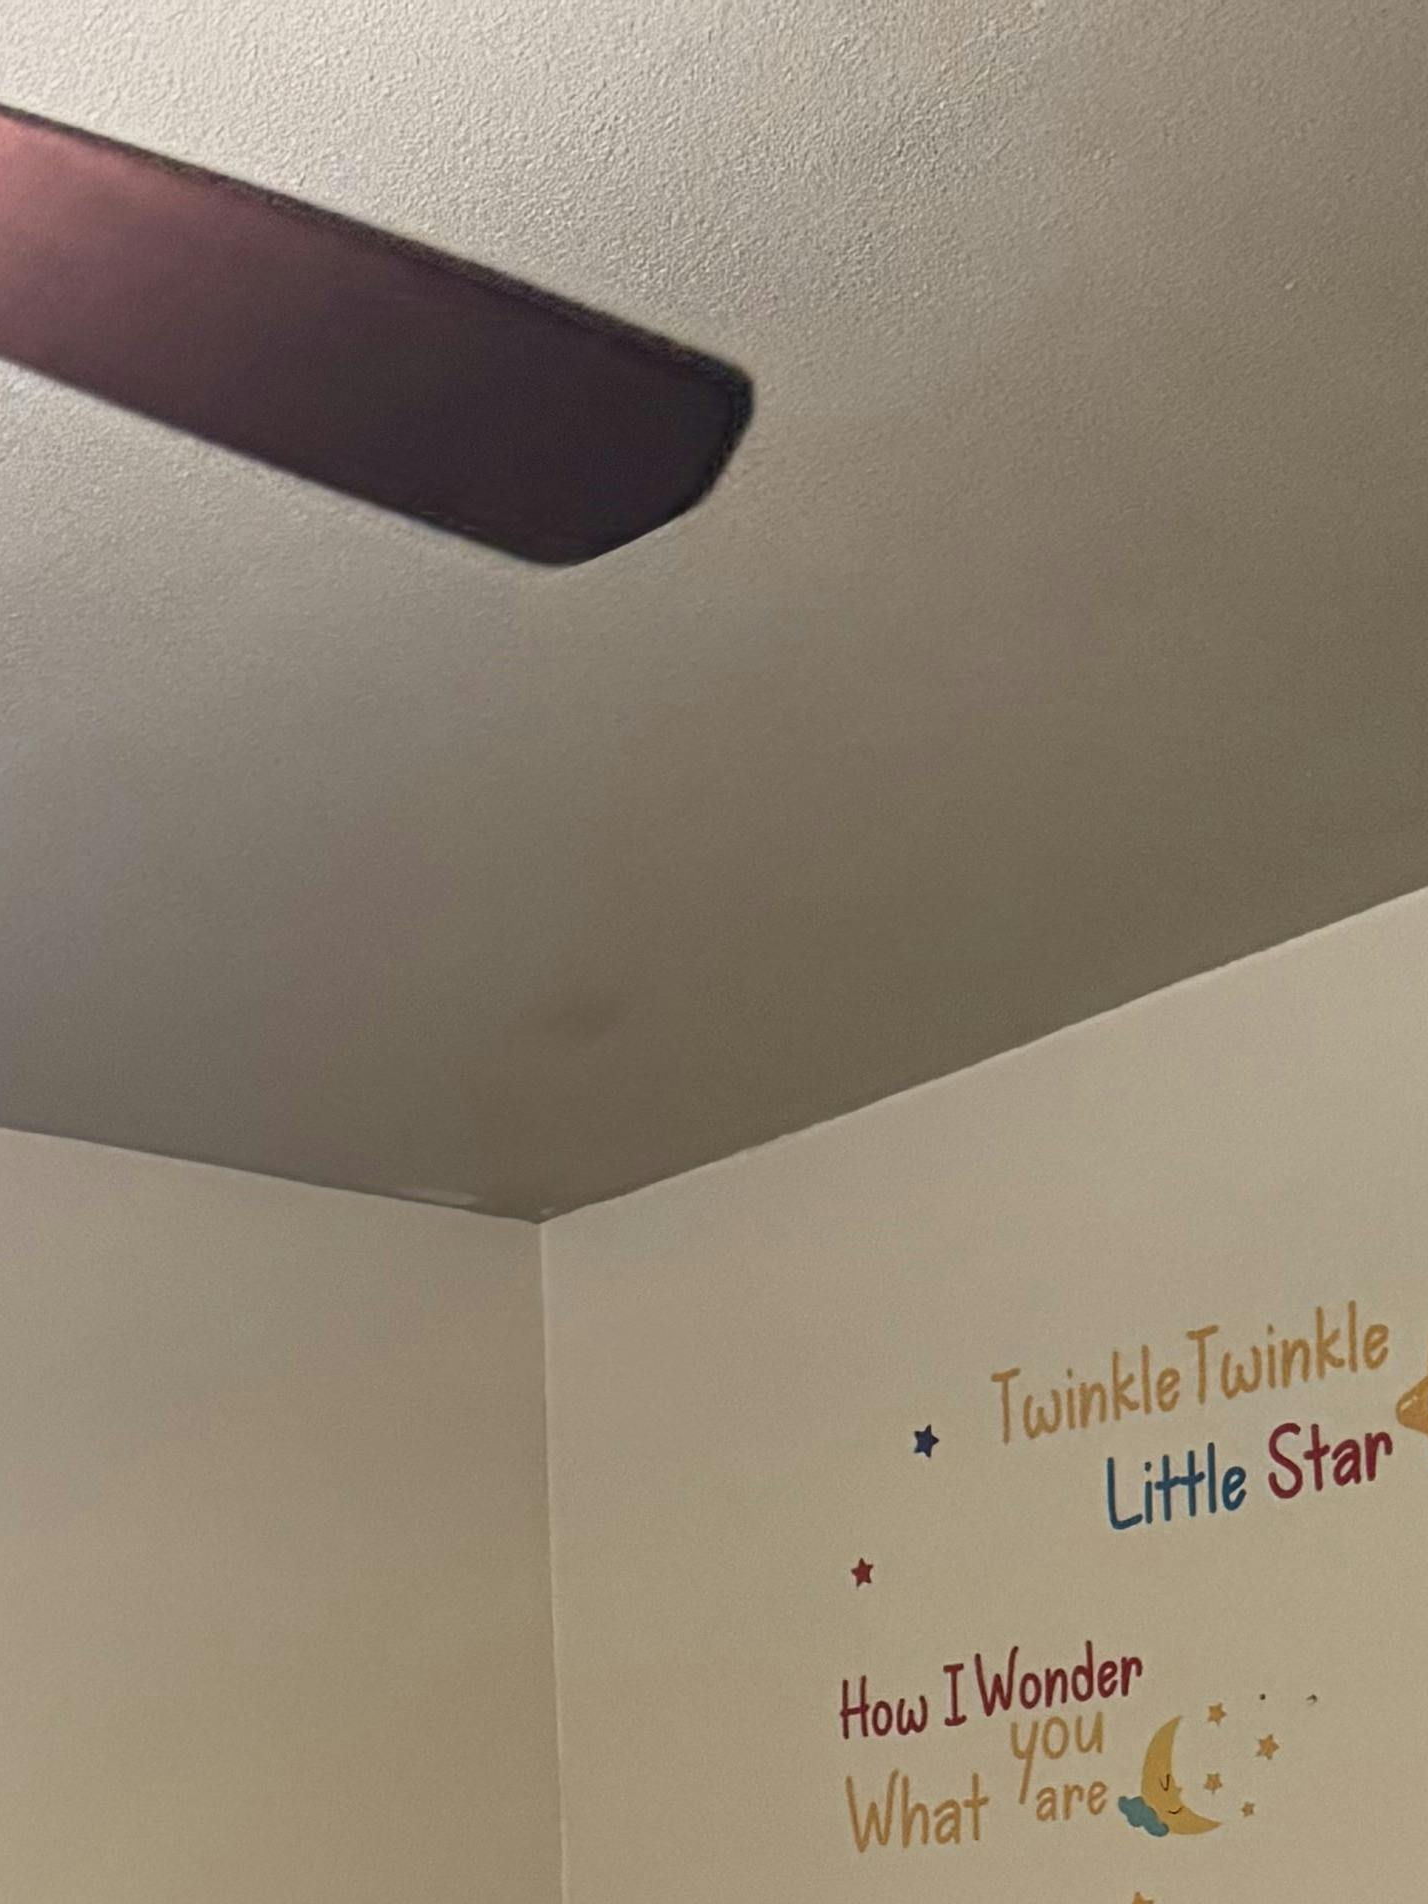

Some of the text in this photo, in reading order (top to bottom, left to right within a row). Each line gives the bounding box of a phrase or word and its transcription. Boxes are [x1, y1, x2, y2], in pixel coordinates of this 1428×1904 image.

[992, 1301, 1390, 1443] Twinkle Twinkle
[1107, 1423, 1393, 1530] Little Star
[840, 1641, 1143, 1740] How I Wonder
[1011, 1711, 1104, 1805] you
[846, 1770, 1108, 1853] What are
